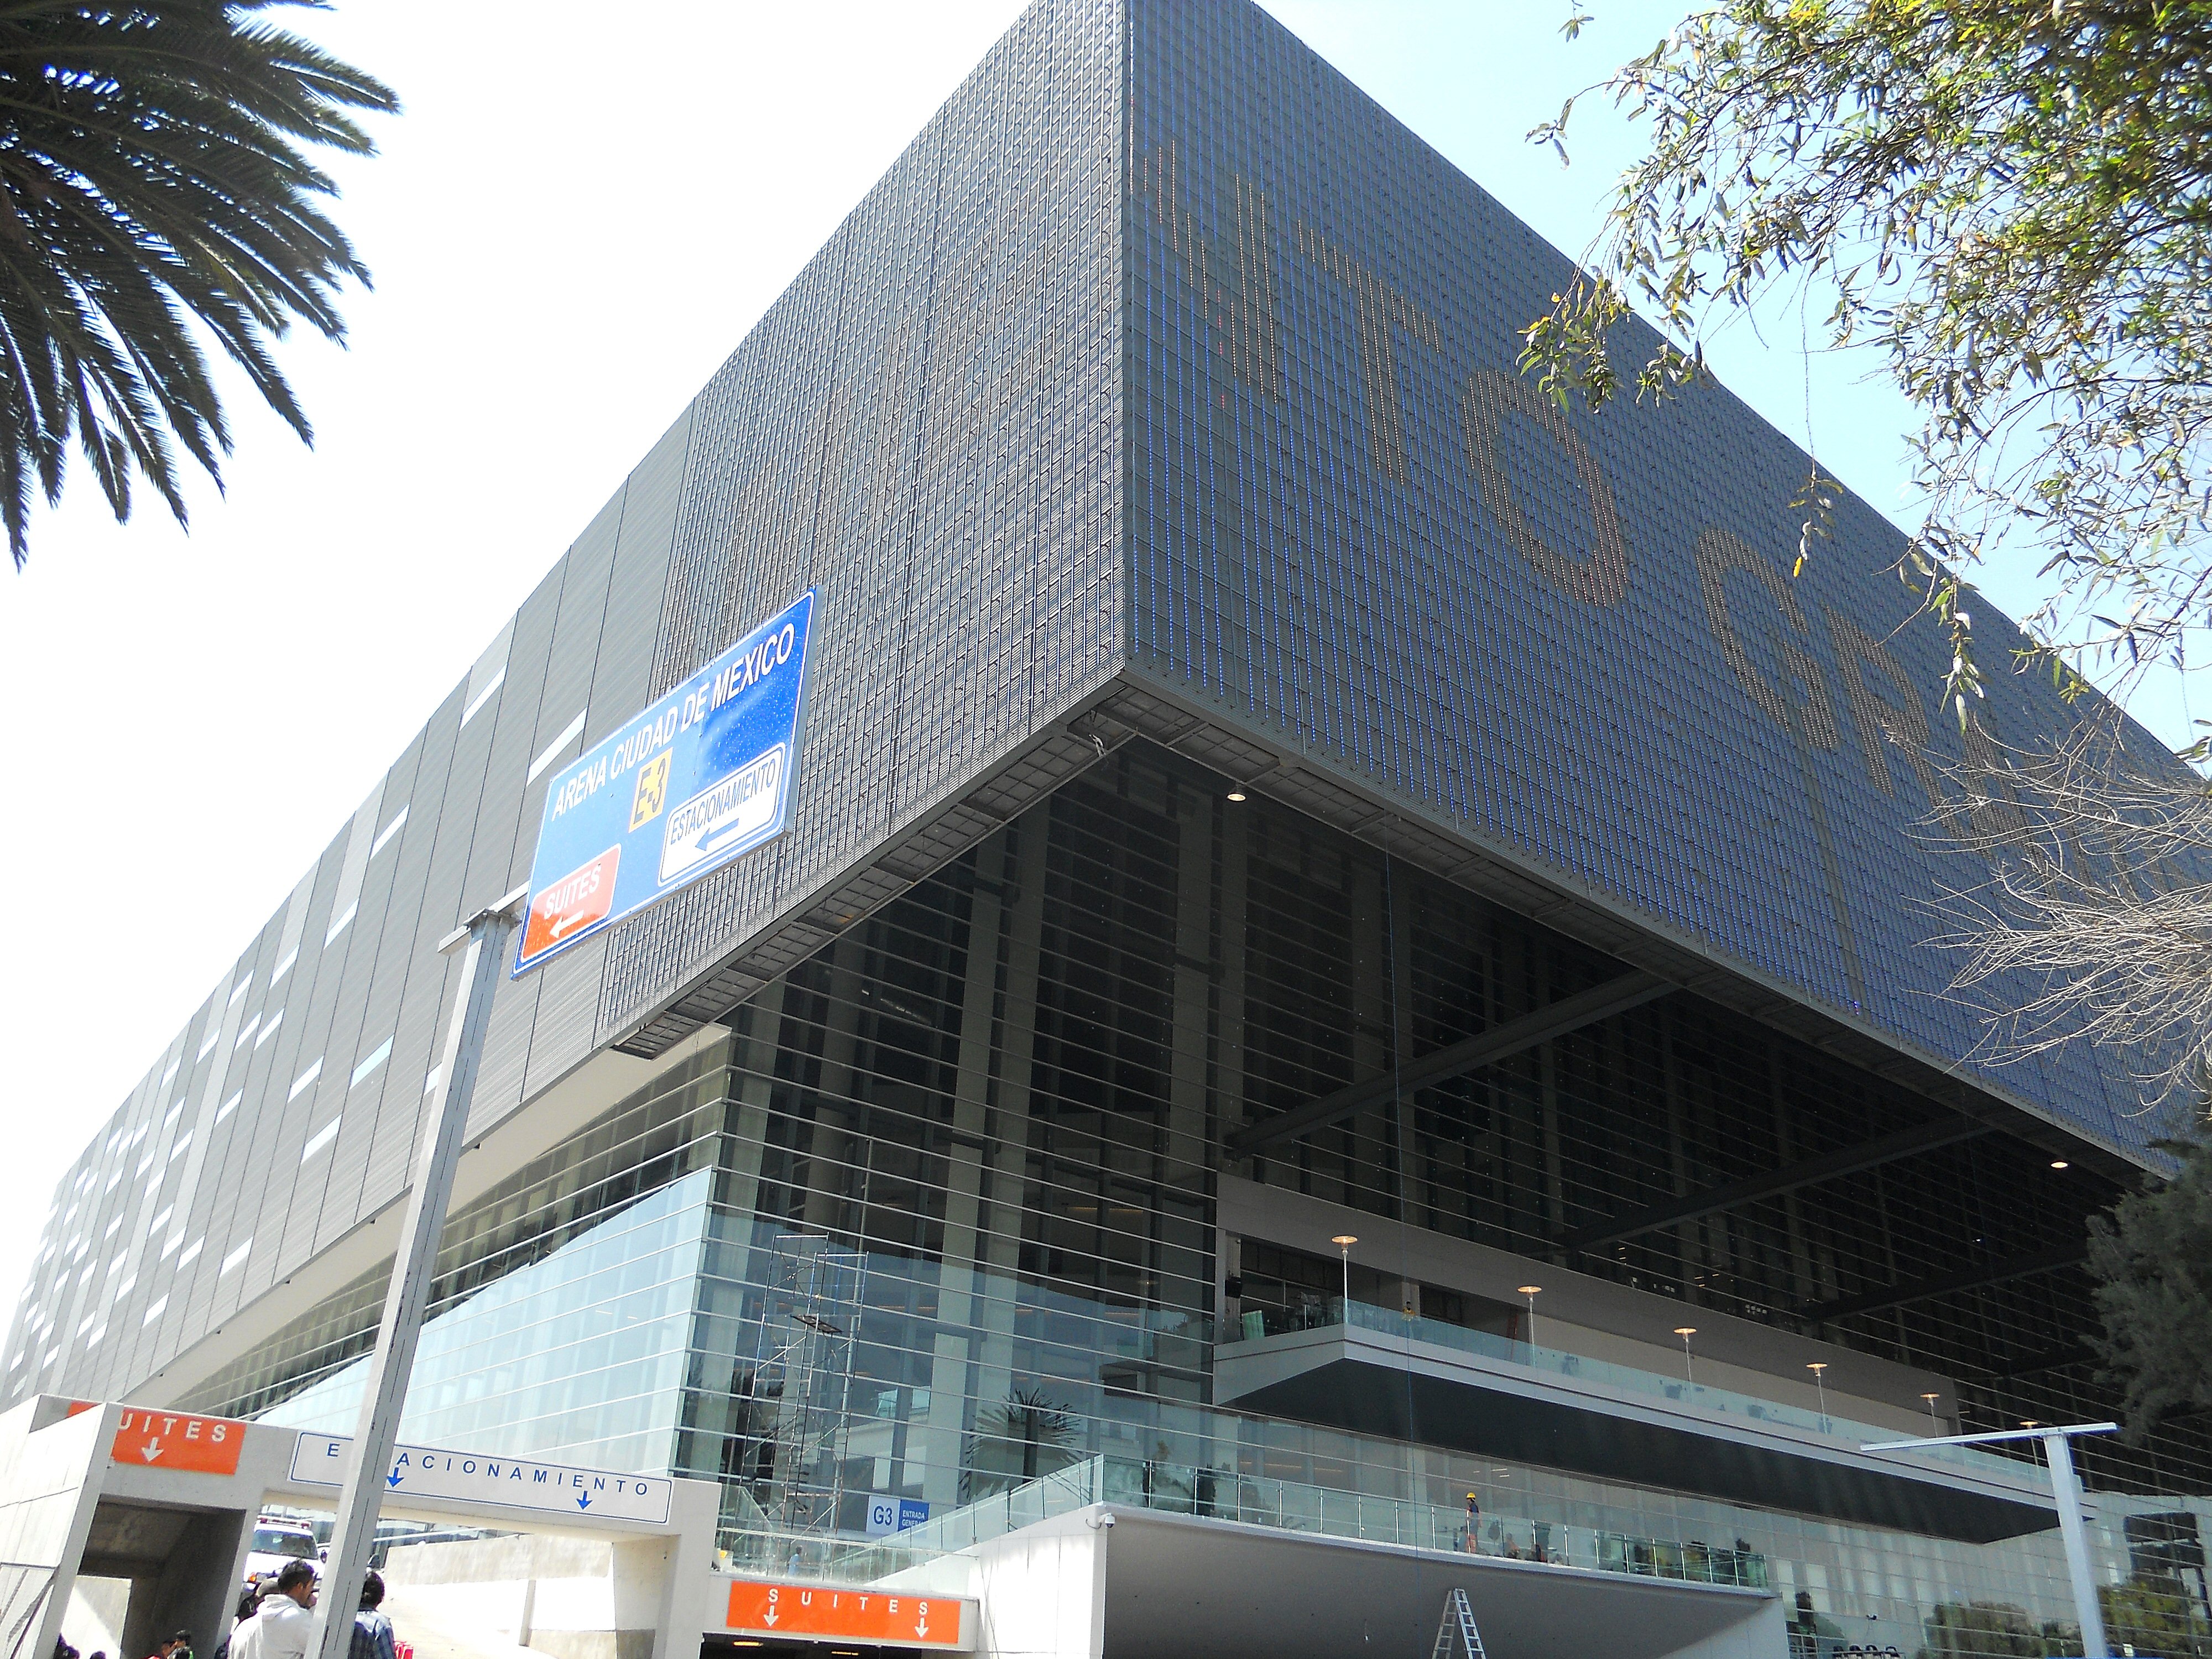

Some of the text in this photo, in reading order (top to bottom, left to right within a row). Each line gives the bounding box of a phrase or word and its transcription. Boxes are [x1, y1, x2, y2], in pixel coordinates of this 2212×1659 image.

[552, 622, 795, 822] ARENA CIUDAD DE MEXICO
[633, 758, 666, 825] E-3
[670, 758, 775, 845] ESTACIONAMIENTO
[544, 864, 602, 920] SUITES
[117, 1413, 226, 1442] UITES
[327, 1443, 648, 1496] EACIONAMIENTO
[874, 1505, 893, 1526] G3
[902, 1510, 925, 1519] ENTRADA
[769, 1588, 928, 1615] SUITES
